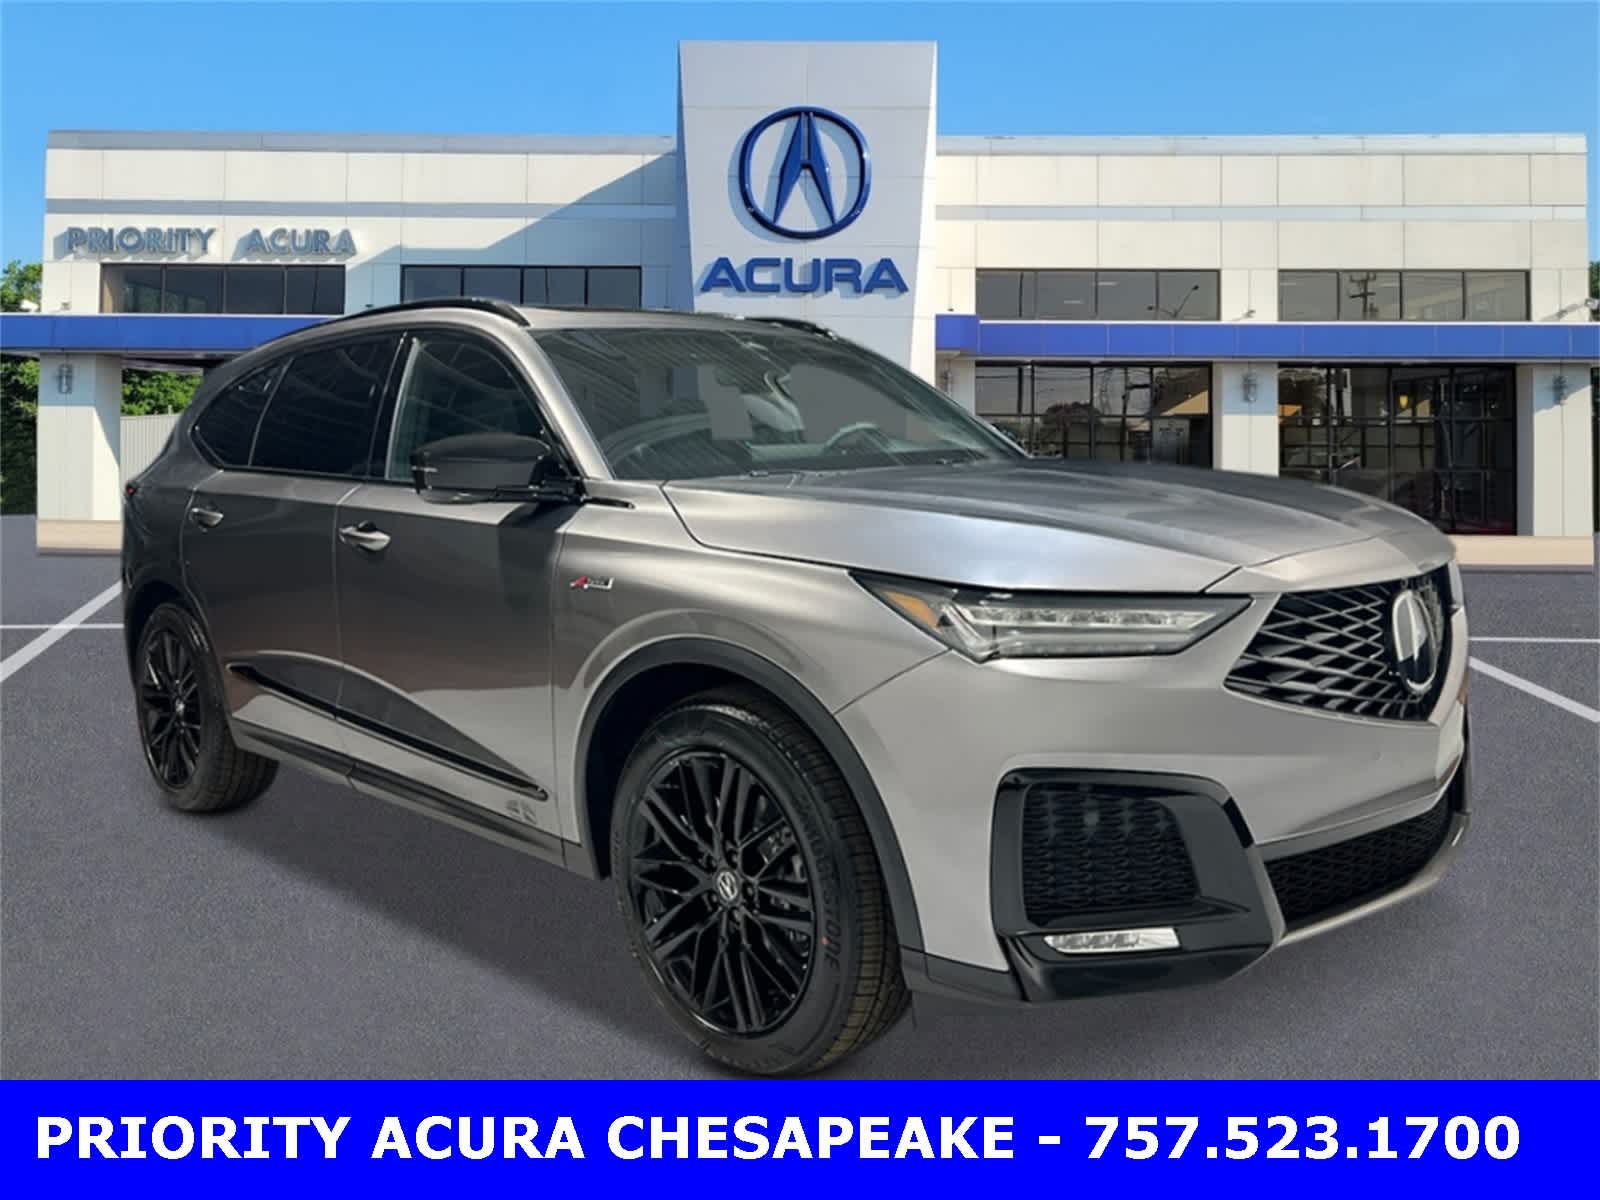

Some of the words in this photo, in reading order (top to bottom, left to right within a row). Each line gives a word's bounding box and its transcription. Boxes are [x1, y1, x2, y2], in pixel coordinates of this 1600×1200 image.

[66, 226, 216, 253] PRIORITY
[247, 227, 357, 255] ACURA
[700, 257, 909, 294] ACURA
